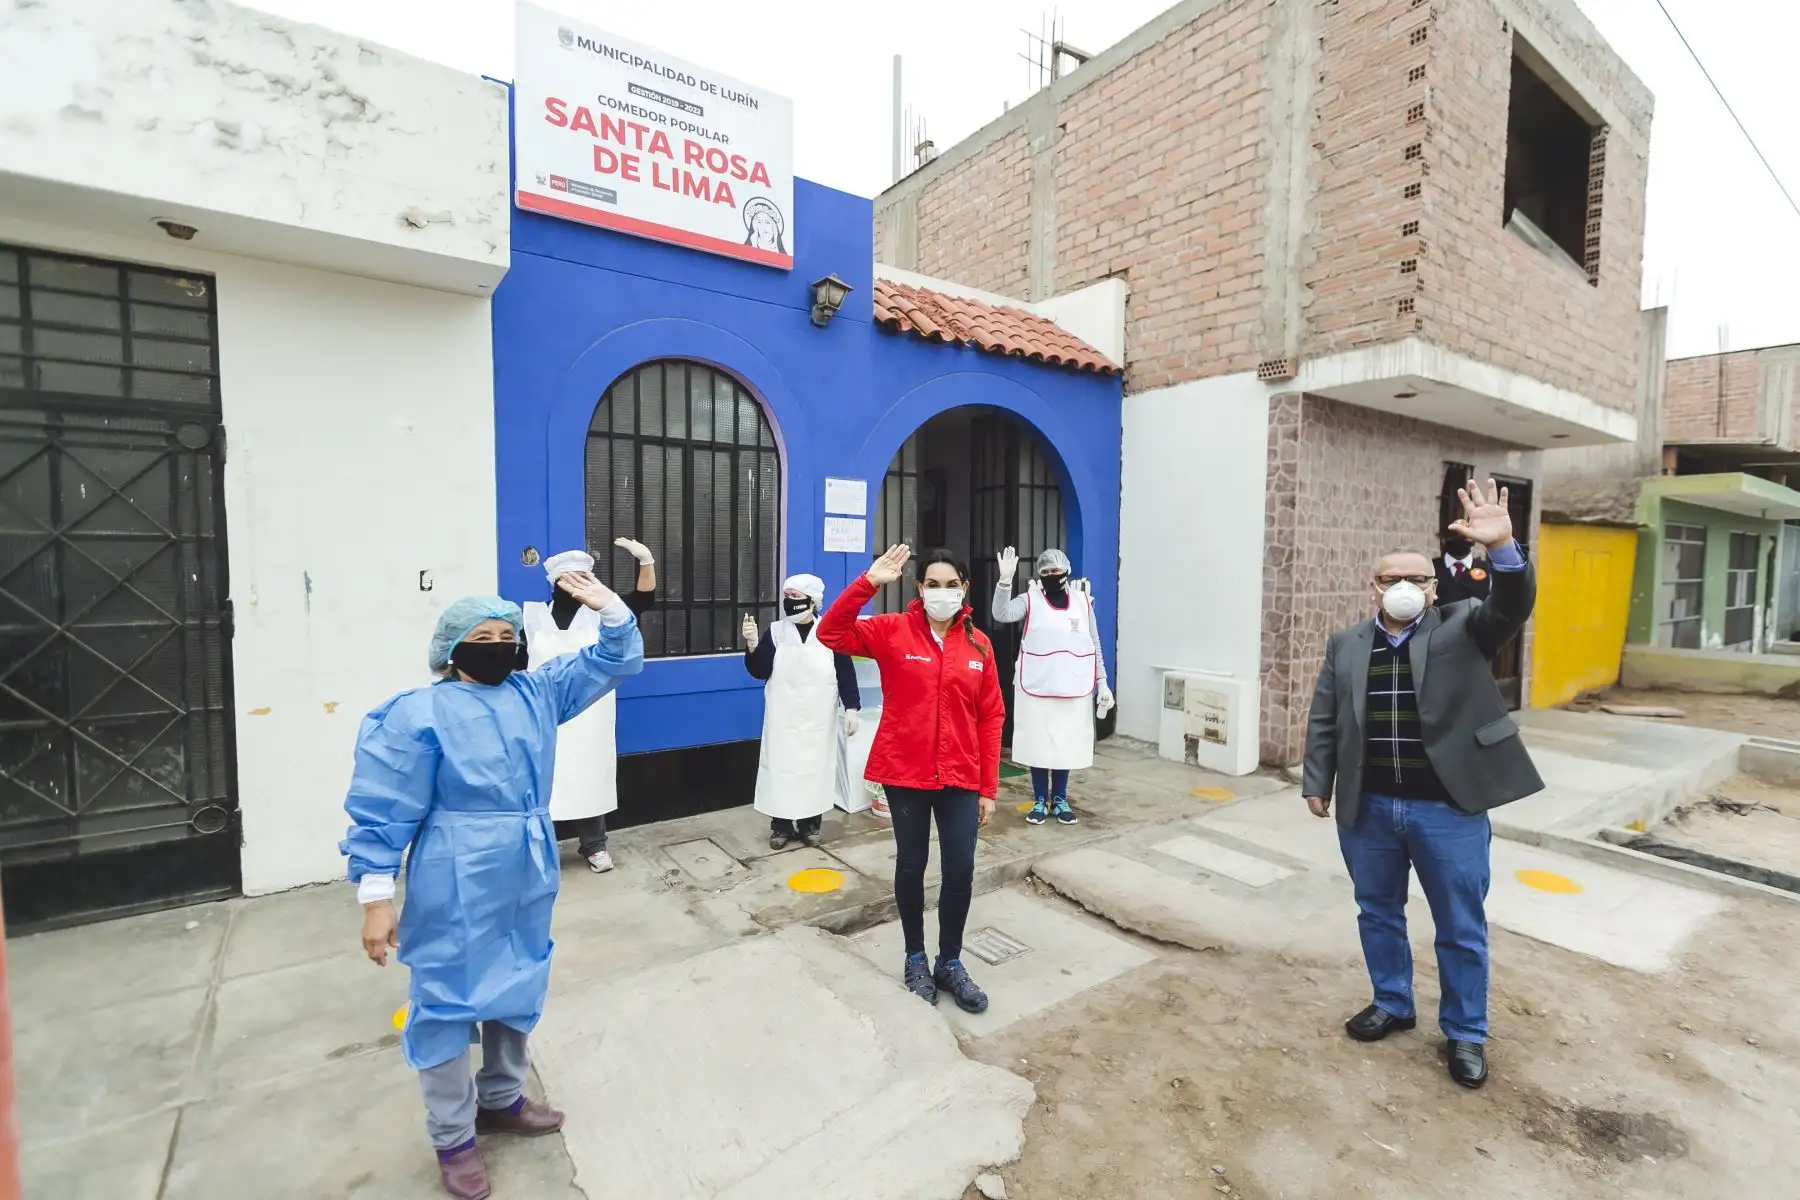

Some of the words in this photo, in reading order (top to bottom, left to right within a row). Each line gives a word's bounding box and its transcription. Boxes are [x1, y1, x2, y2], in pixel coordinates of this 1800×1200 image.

[577, 35, 696, 87] MUNICIPALIDAD
[700, 80, 718, 96] DE
[721, 87, 758, 110] LURÍN
[631, 87, 662, 102] GESTIÓN
[662, 97, 679, 108] 2019
[684, 104, 701, 115] 2022
[545, 97, 674, 160] SANTA
[684, 139, 771, 188] ROSA
[597, 95, 667, 126] COMEDOR
[670, 119, 729, 145] POPULAR
[594, 145, 641, 183] DE
[652, 161, 736, 209] LIMA
